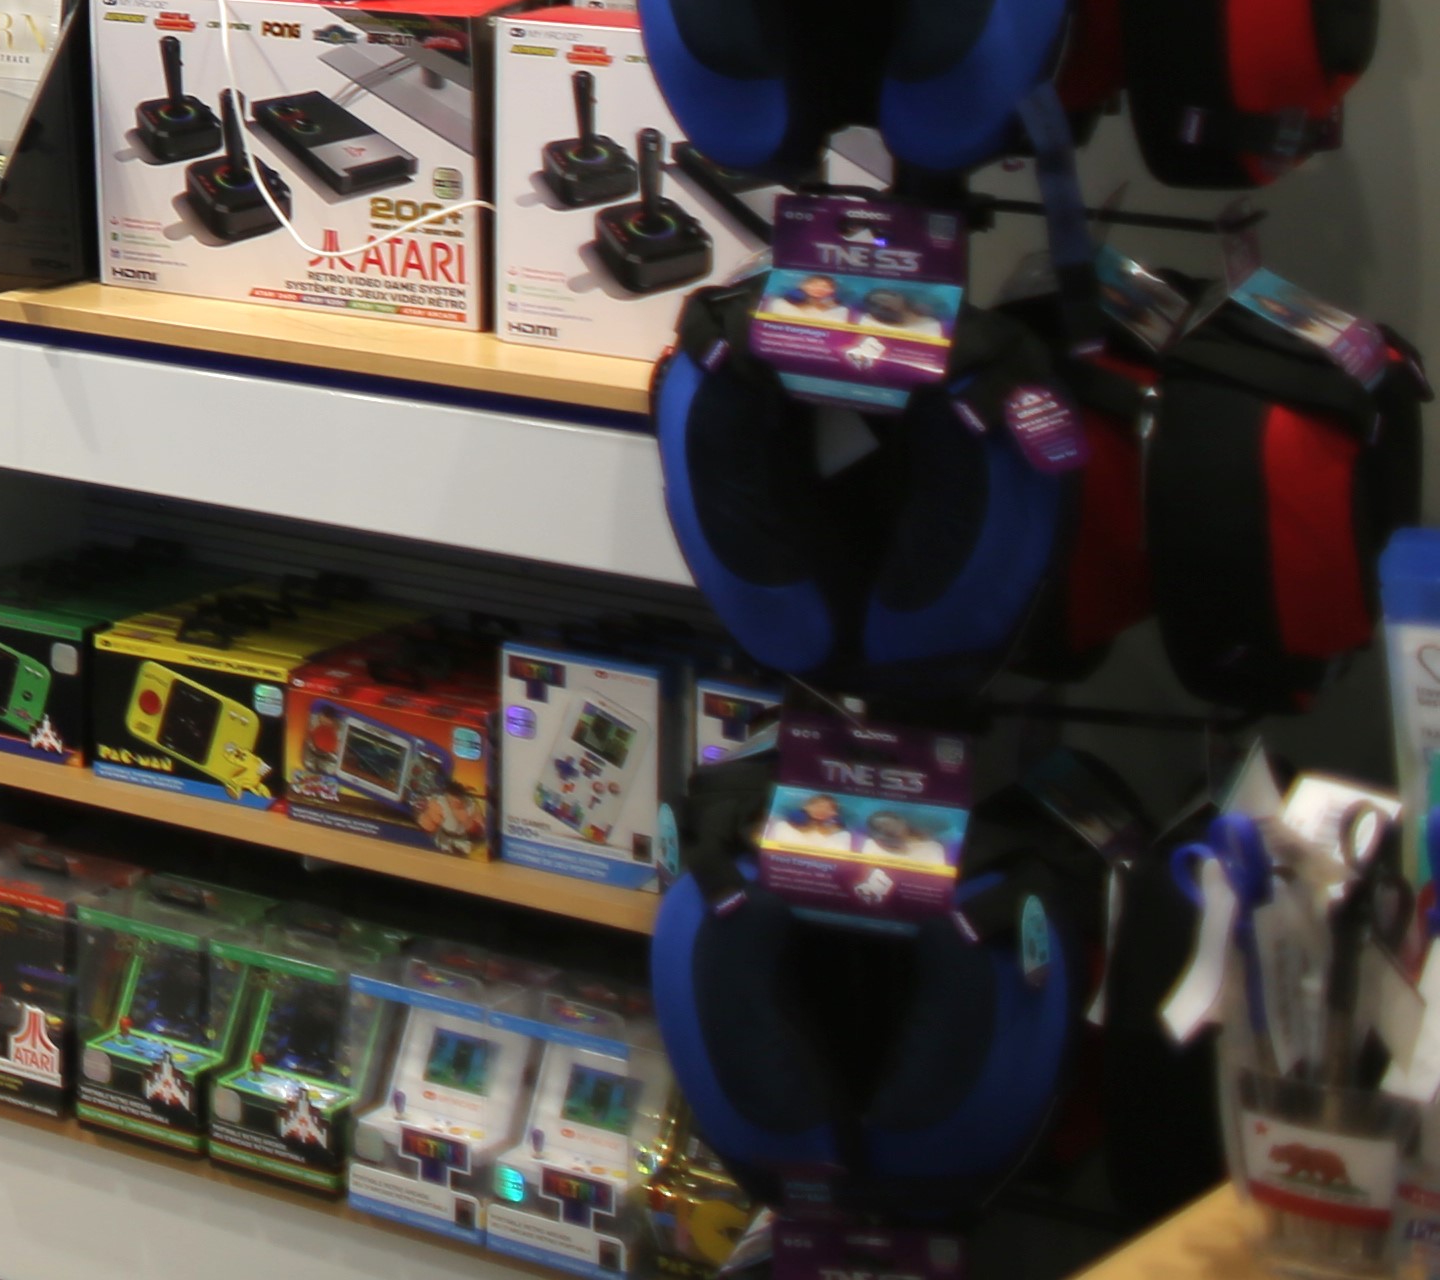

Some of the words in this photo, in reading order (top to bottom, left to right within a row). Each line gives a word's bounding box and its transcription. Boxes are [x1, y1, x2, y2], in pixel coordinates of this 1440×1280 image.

[111, 266, 158, 282] HDMI
[360, 241, 466, 284] ATARI
[12, 1044, 55, 1073] ATARI
